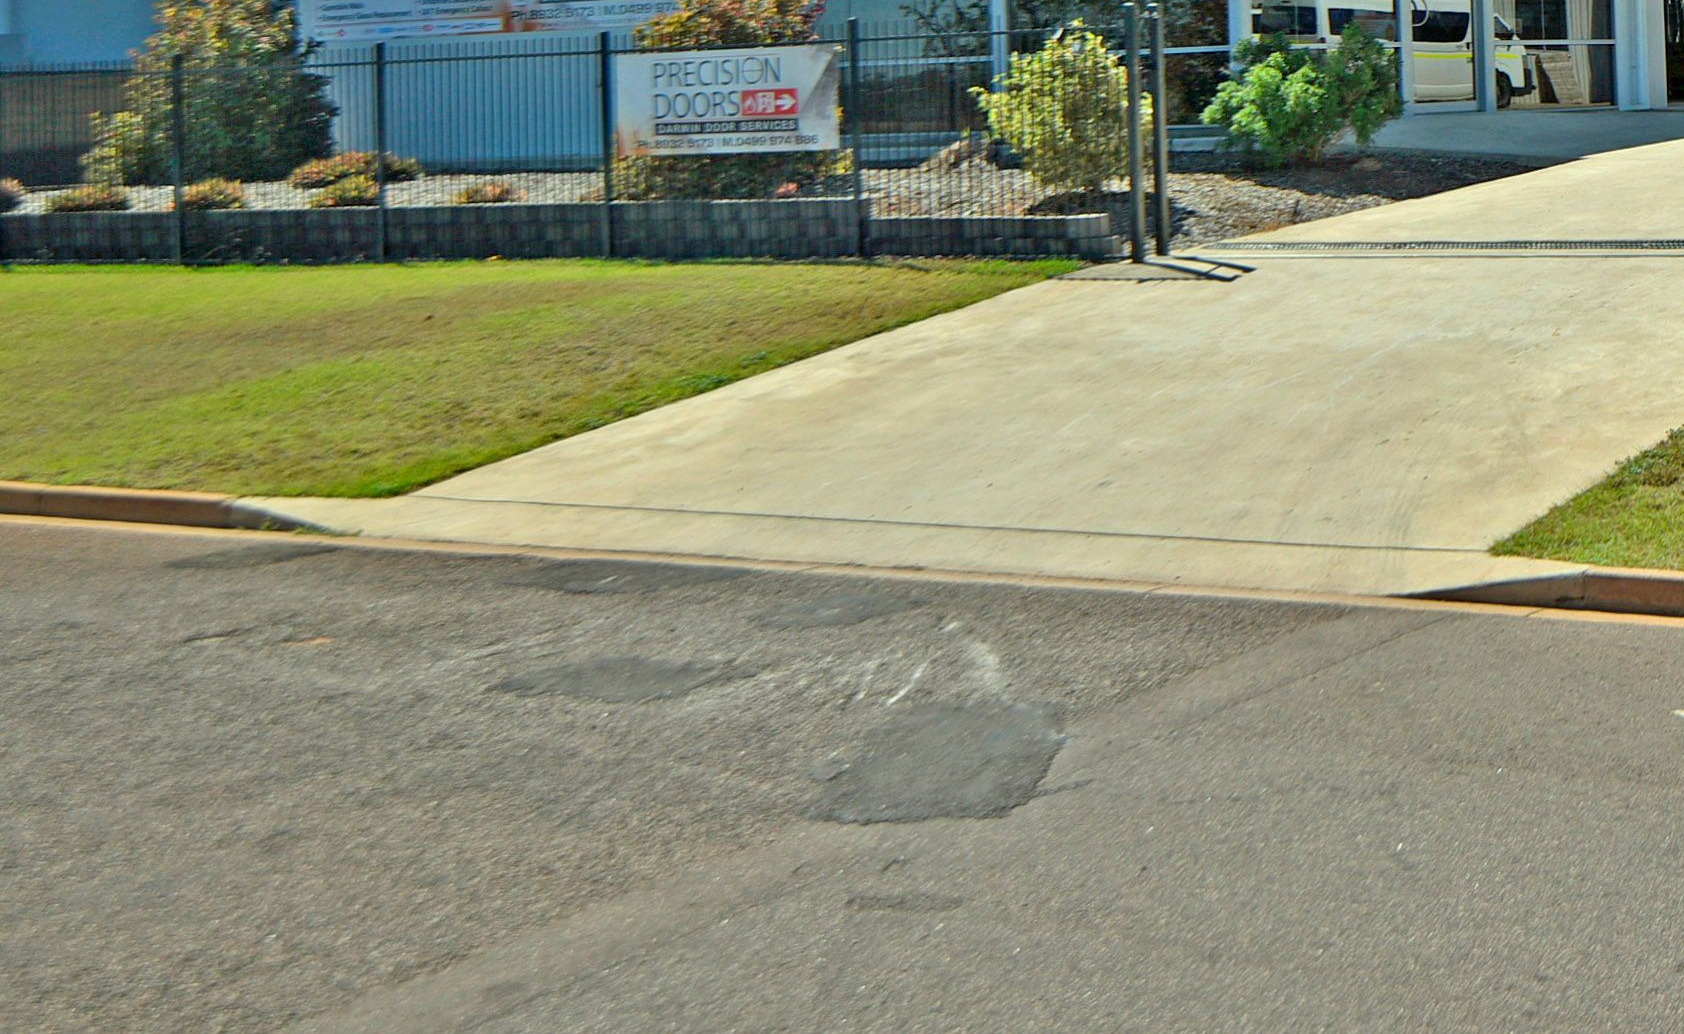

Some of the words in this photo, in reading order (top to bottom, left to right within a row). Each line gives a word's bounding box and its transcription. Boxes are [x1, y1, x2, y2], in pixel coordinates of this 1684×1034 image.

[653, 56, 781, 87] PRECISION
[653, 90, 741, 119] DOORS
[657, 123, 702, 134] DARWIN
[705, 122, 737, 133] DOOR
[740, 120, 796, 132] SERVICES
